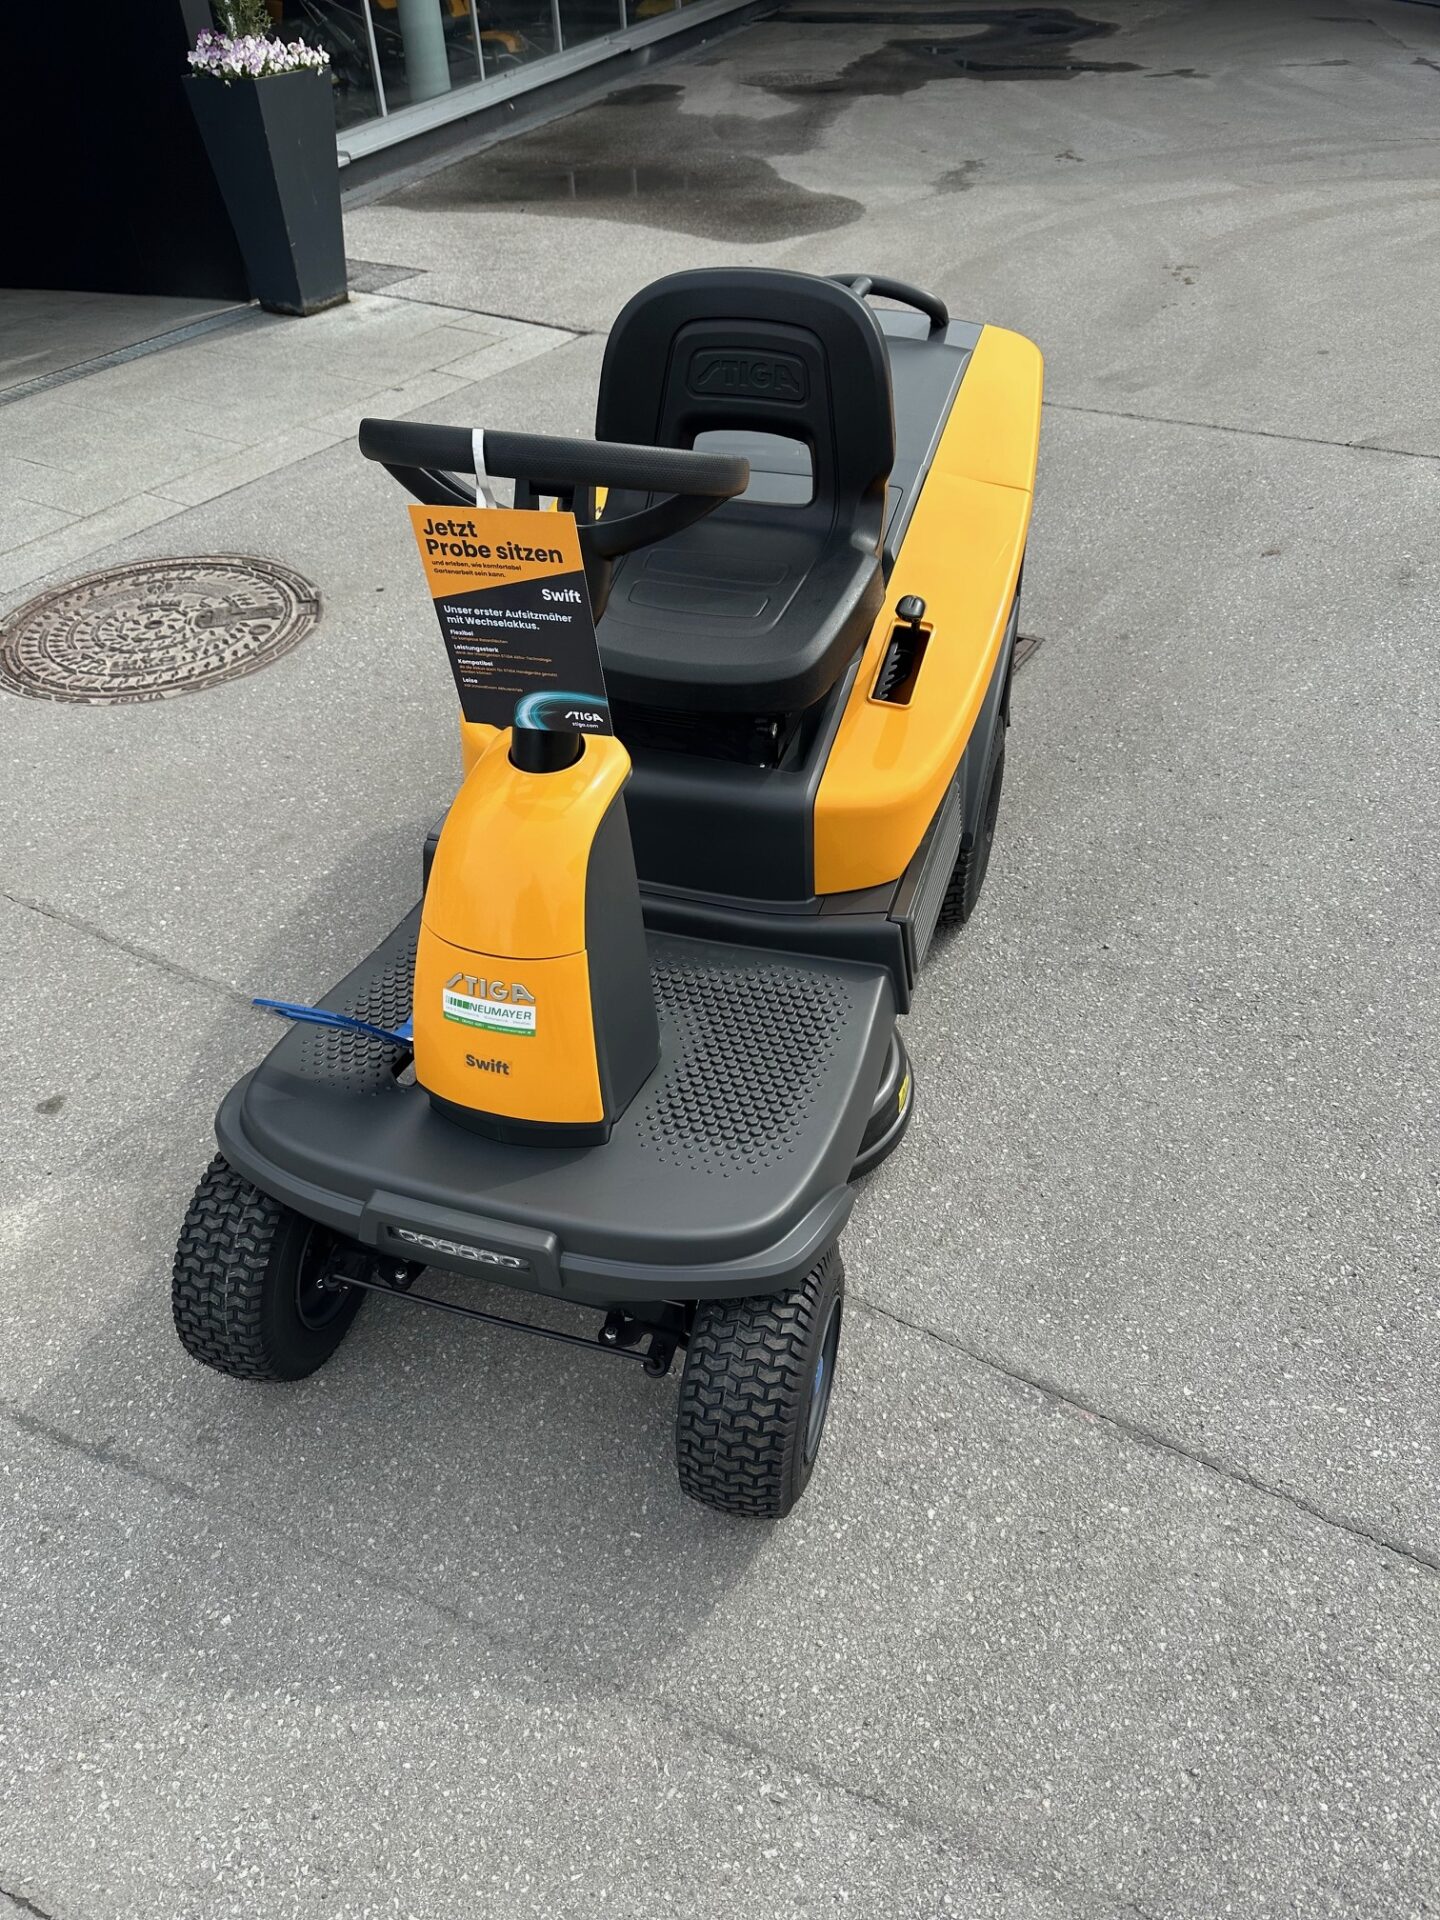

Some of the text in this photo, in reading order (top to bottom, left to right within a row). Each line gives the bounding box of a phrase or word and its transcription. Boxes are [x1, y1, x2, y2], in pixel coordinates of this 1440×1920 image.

[698, 359, 800, 393] STIGA
[423, 518, 478, 538] Jetzt
[426, 538, 564, 564] Probe sitzen
[433, 568, 473, 576] Gartenarbeit
[483, 562, 522, 571] komfortabel
[541, 588, 582, 604] Swift
[443, 604, 573, 624] Unser erster Aufsitzmäher
[446, 614, 540, 631] mit Wechselakkus.
[450, 628, 474, 637] Flexibel
[453, 643, 499, 653] Leistungsstark
[457, 658, 494, 668] Kompatibel
[564, 711, 604, 723] STIGA
[572, 721, 599, 729] stiga.com
[446, 972, 536, 1005] STIGA
[468, 1001, 532, 1021] NEUMAYER
[465, 1053, 510, 1075] Swift
